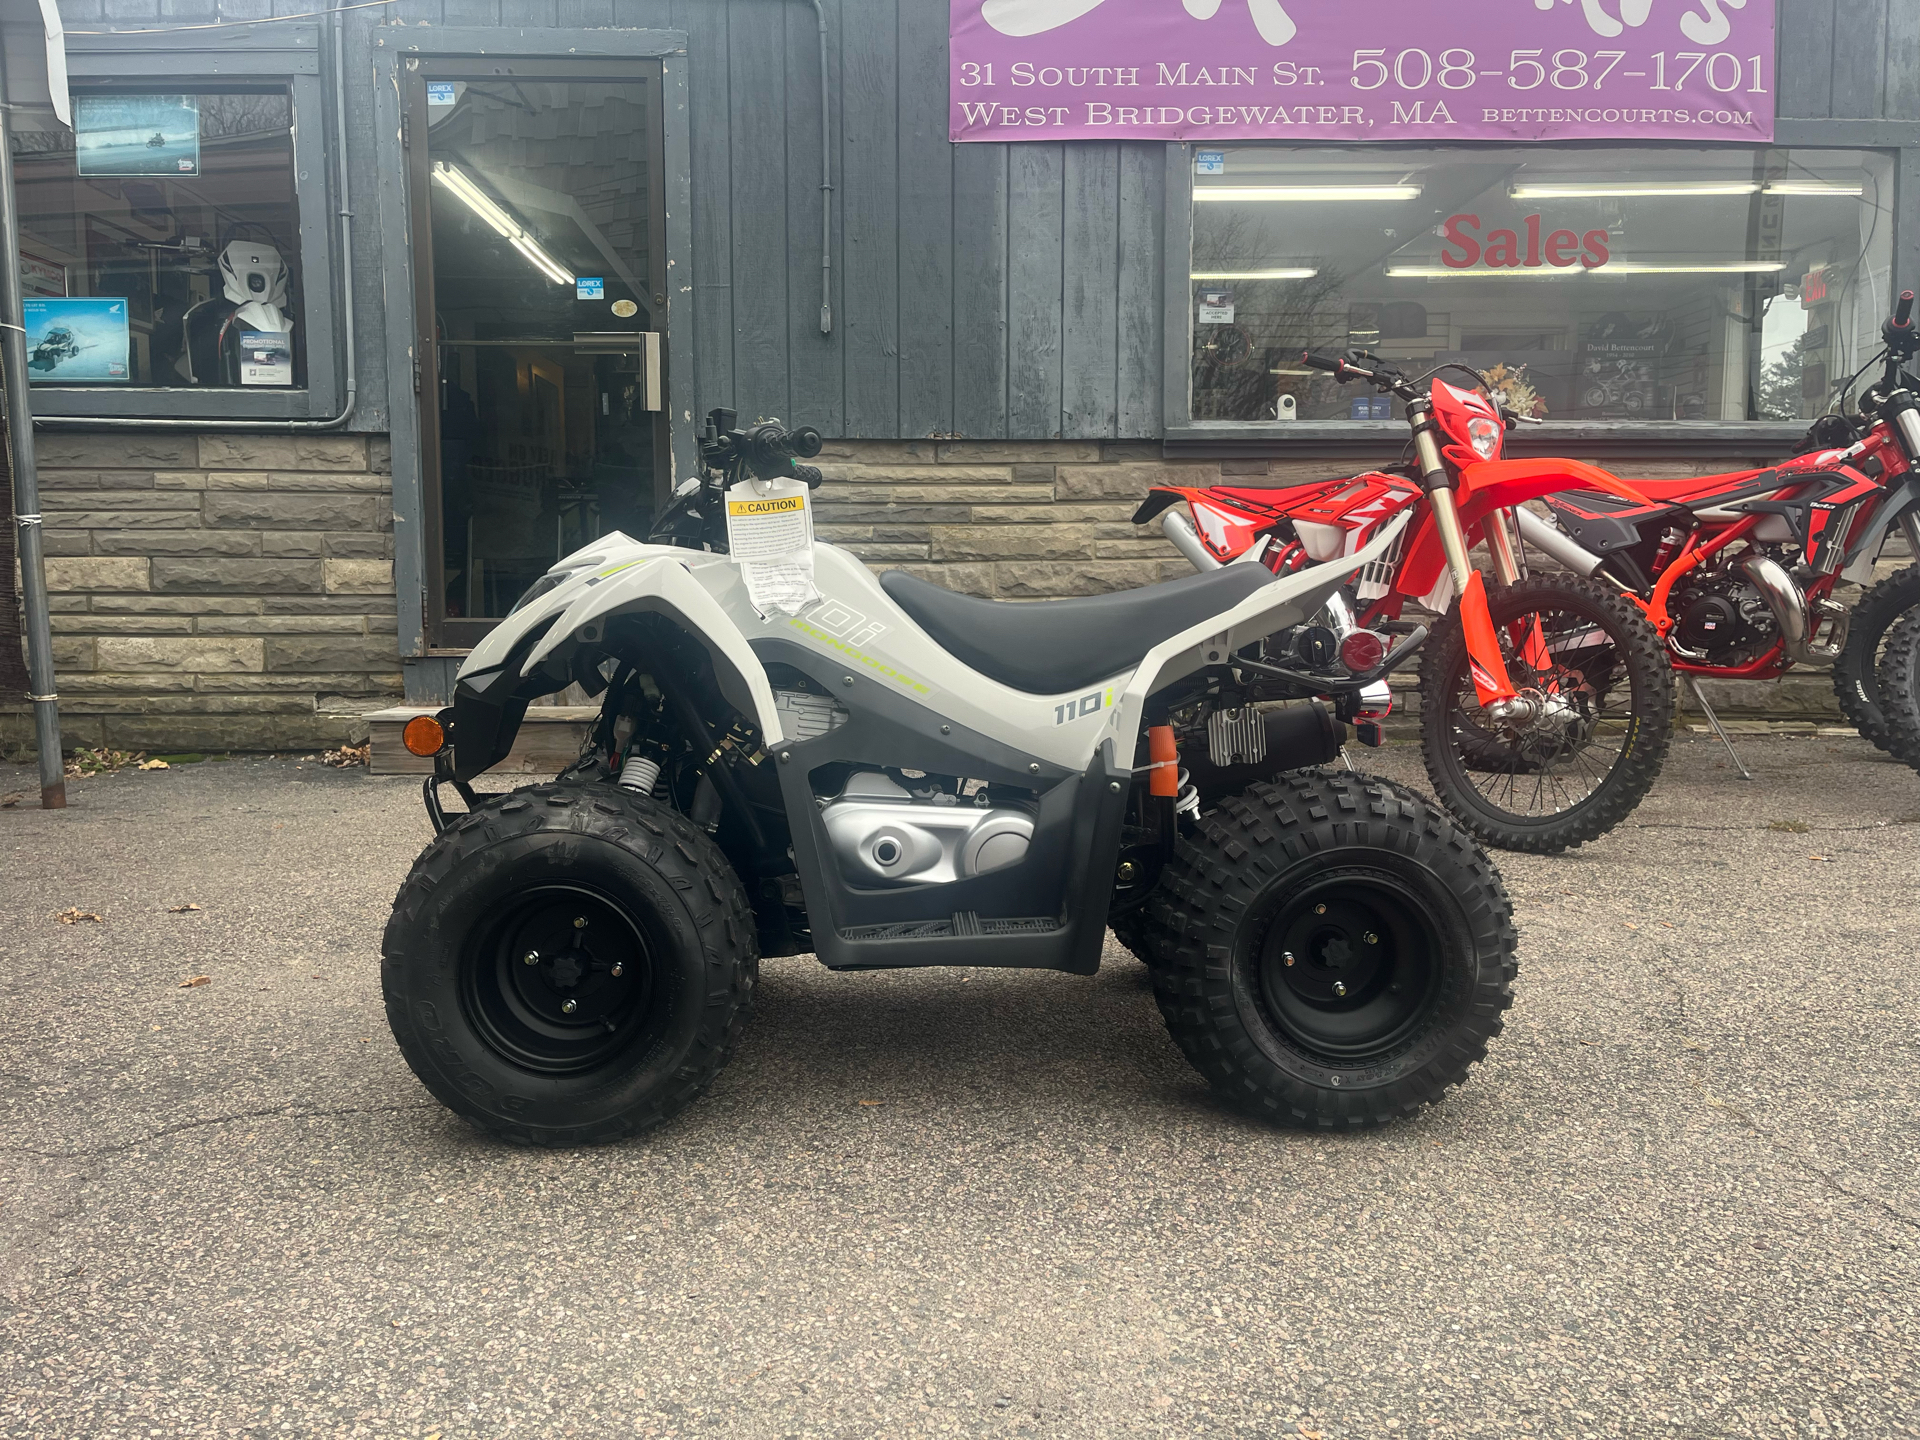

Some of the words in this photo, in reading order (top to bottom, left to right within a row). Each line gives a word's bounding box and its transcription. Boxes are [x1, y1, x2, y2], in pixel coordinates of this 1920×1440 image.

[959, 62, 996, 87] 31
[1349, 47, 1768, 93] 508-587-1701
[957, 102, 1070, 126] WEST
[1389, 101, 1458, 125] MA
[1441, 213, 1610, 269] Sales
[578, 280, 601, 288] LOREX
[1587, 343, 1609, 351] David
[1611, 344, 1655, 352] Bettencourt
[747, 499, 797, 513] CAUTION
[1809, 501, 1836, 510] Beta
